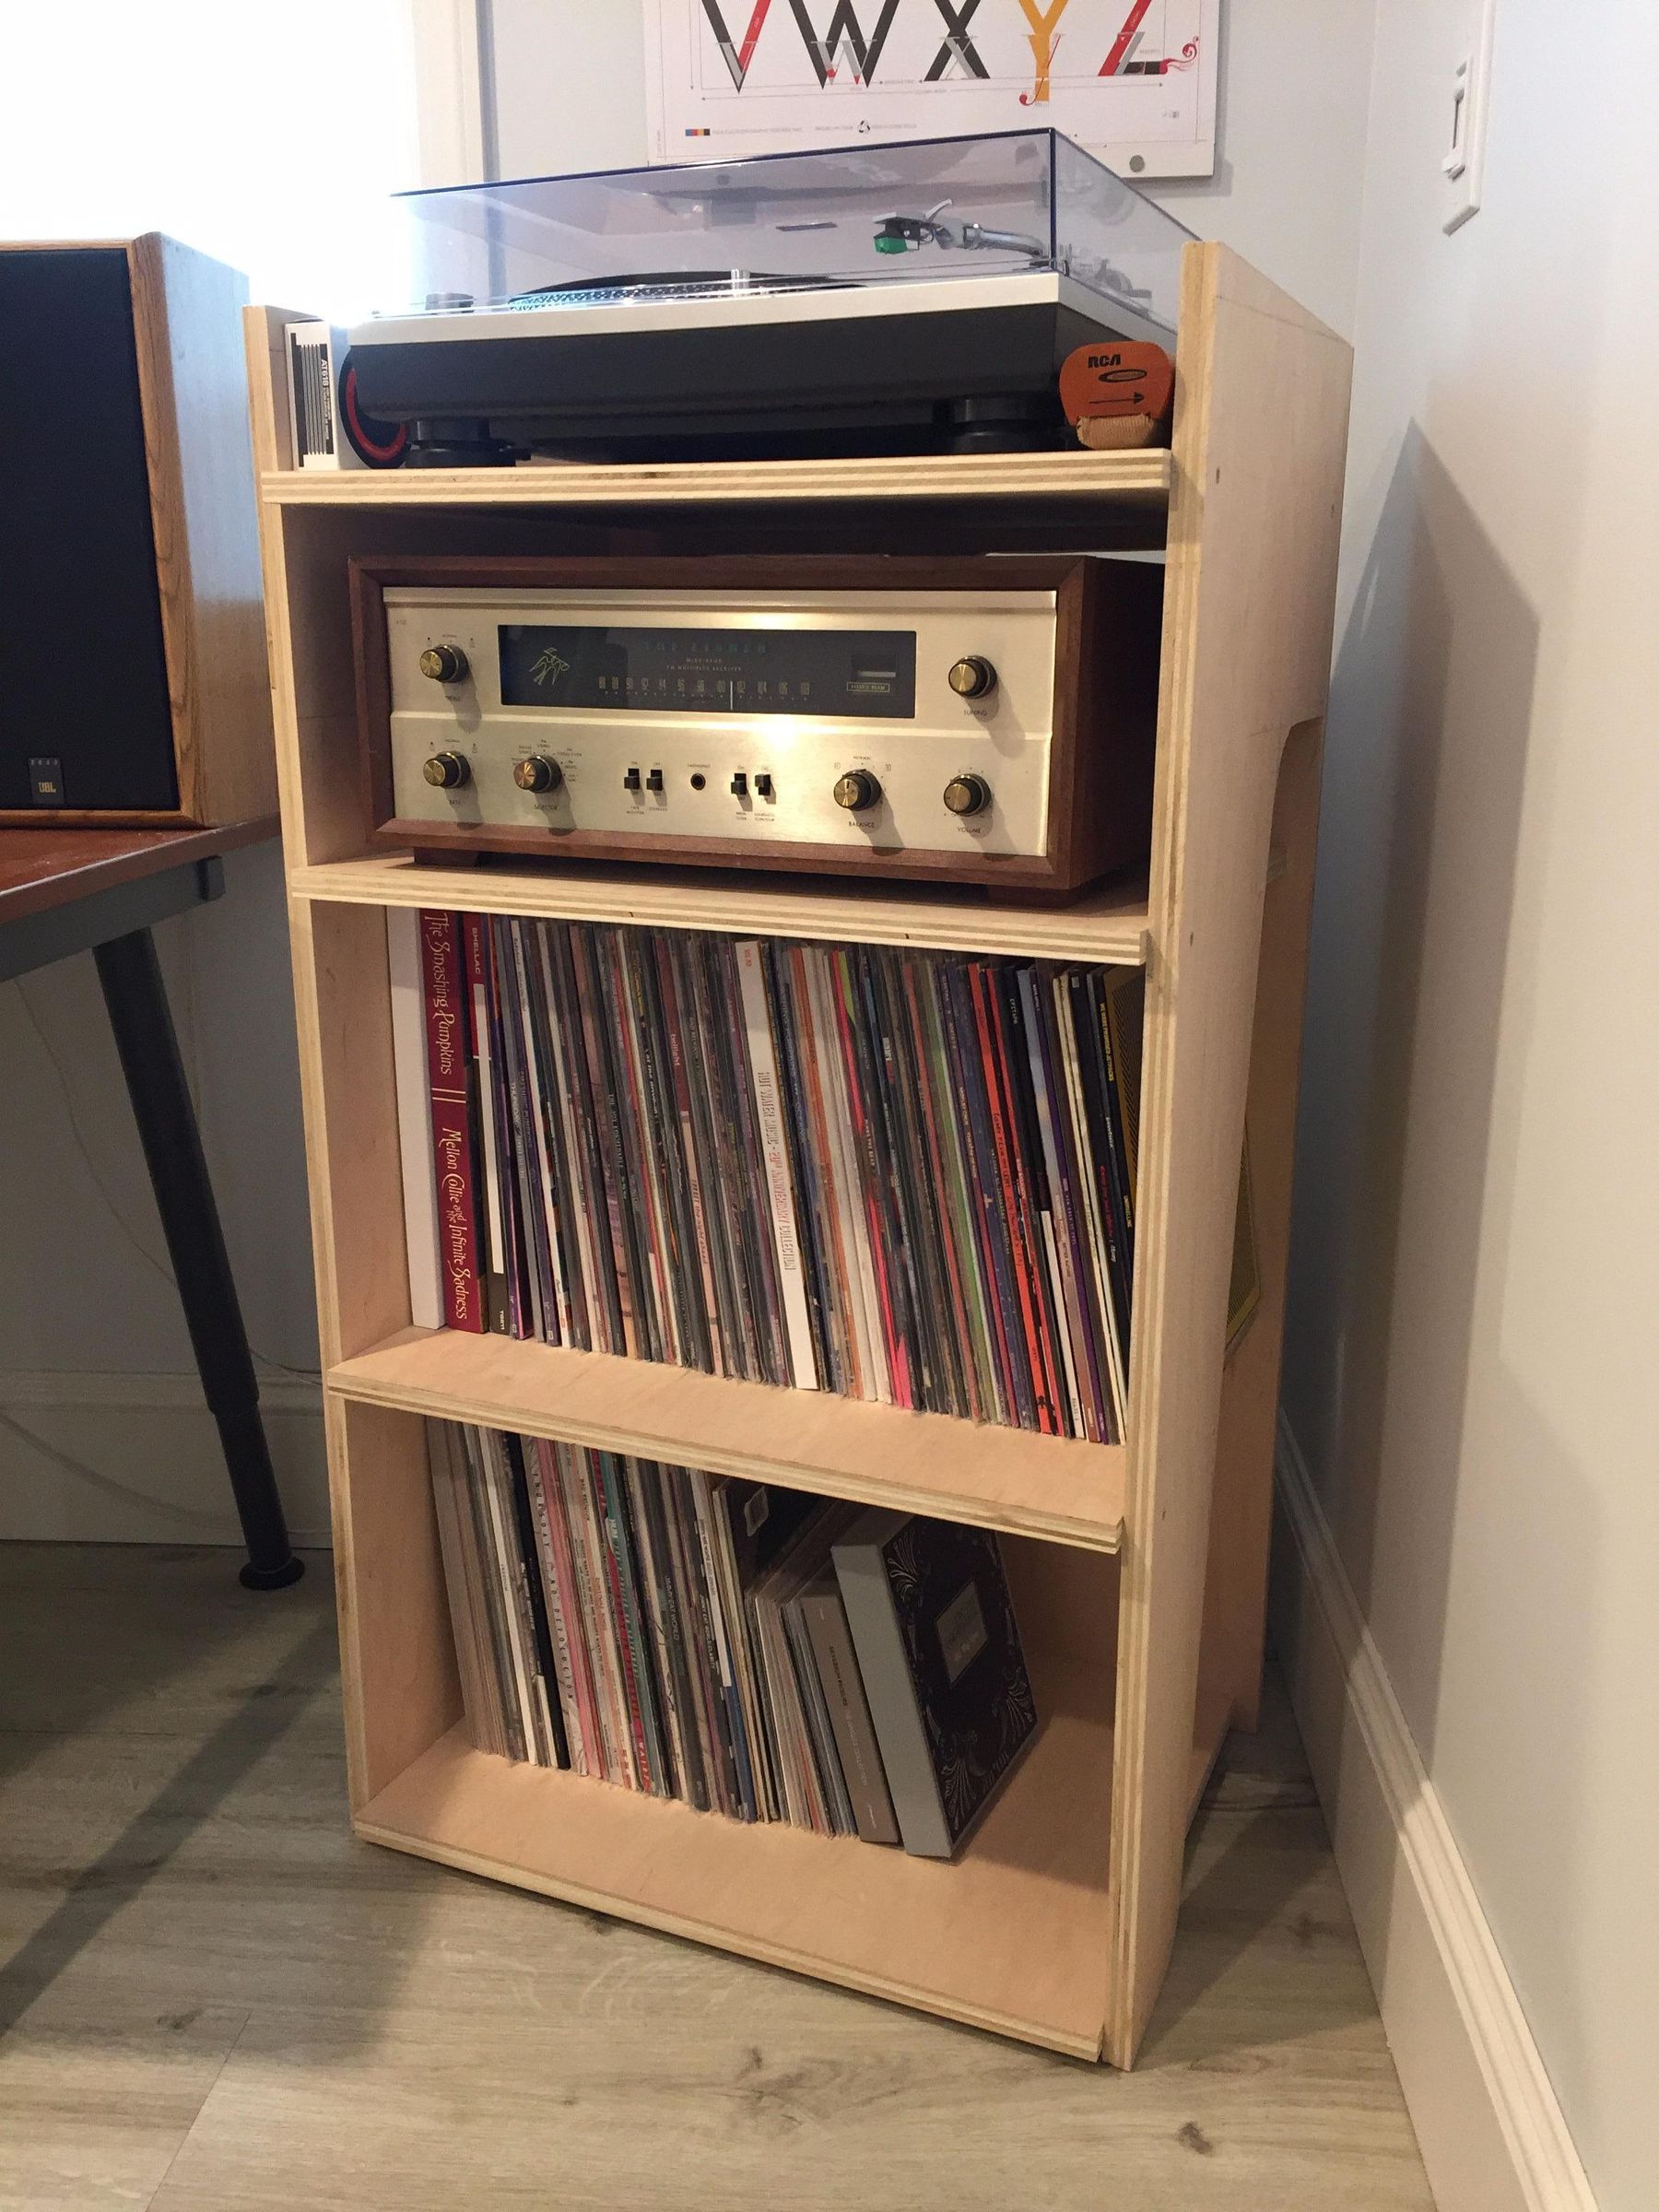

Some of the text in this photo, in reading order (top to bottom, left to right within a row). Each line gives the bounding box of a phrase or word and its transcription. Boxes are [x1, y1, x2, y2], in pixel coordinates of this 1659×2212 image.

[1088, 354, 1122, 369] RCA
[848, 820, 876, 830] BALANCE
[957, 826, 982, 834] VOLUME
[471, 927, 480, 974] SHELLAC
[425, 912, 453, 1075] The Smashing Pumpkins
[1009, 997, 1018, 1025] EPITAPH
[668, 1033, 681, 1066] twilight
[759, 1089, 775, 1118] WATER
[764, 1118, 779, 1146] MUSIC
[771, 1168, 789, 1224] ANNIVERSARY
[438, 1128, 472, 1320] Mellon Collie and the Infinite Sadness
[779, 1224, 796, 1271] COLLECTION
[530, 1472, 551, 1547] THURSDAY
[608, 1517, 618, 1539] HUM
[667, 1598, 676, 1613] EAT
[669, 1613, 680, 1641] WORLD
